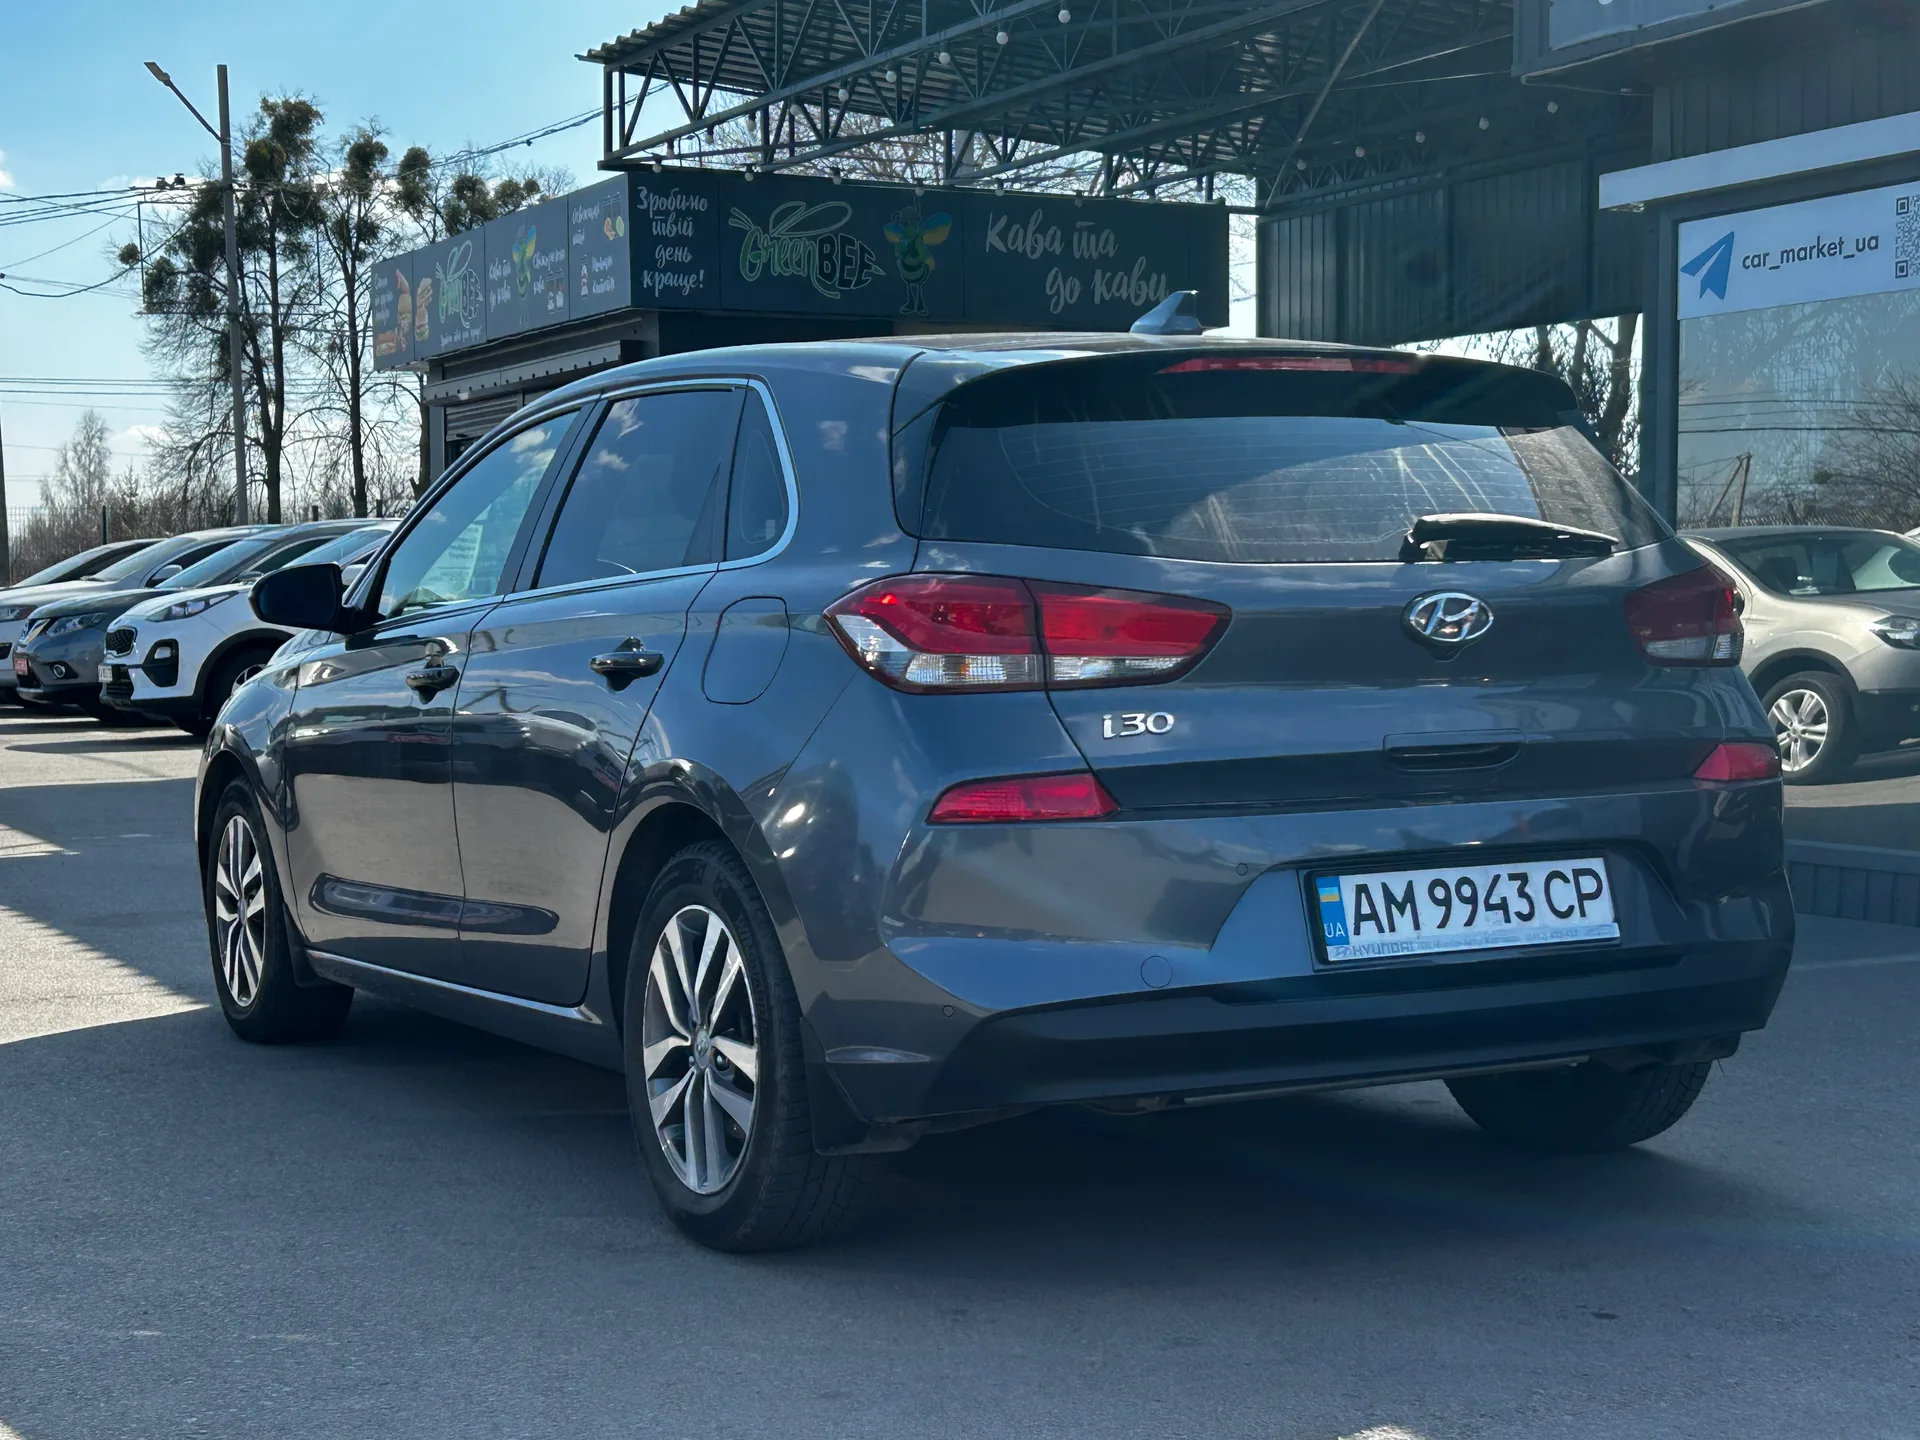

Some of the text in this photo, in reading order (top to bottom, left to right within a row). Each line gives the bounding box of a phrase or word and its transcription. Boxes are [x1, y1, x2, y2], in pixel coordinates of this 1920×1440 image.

[636, 186, 709, 219] Зробимо
[651, 212, 695, 238] твій
[985, 208, 1119, 260] Кава та
[654, 243, 694, 269] день
[1741, 235, 1879, 271] car_market_ua
[642, 269, 705, 298] краще!
[1045, 256, 1169, 314] до кави
[1102, 711, 1175, 739] i30
[1352, 867, 1604, 936] AM 9943 CP
[1323, 922, 1346, 938] UA
